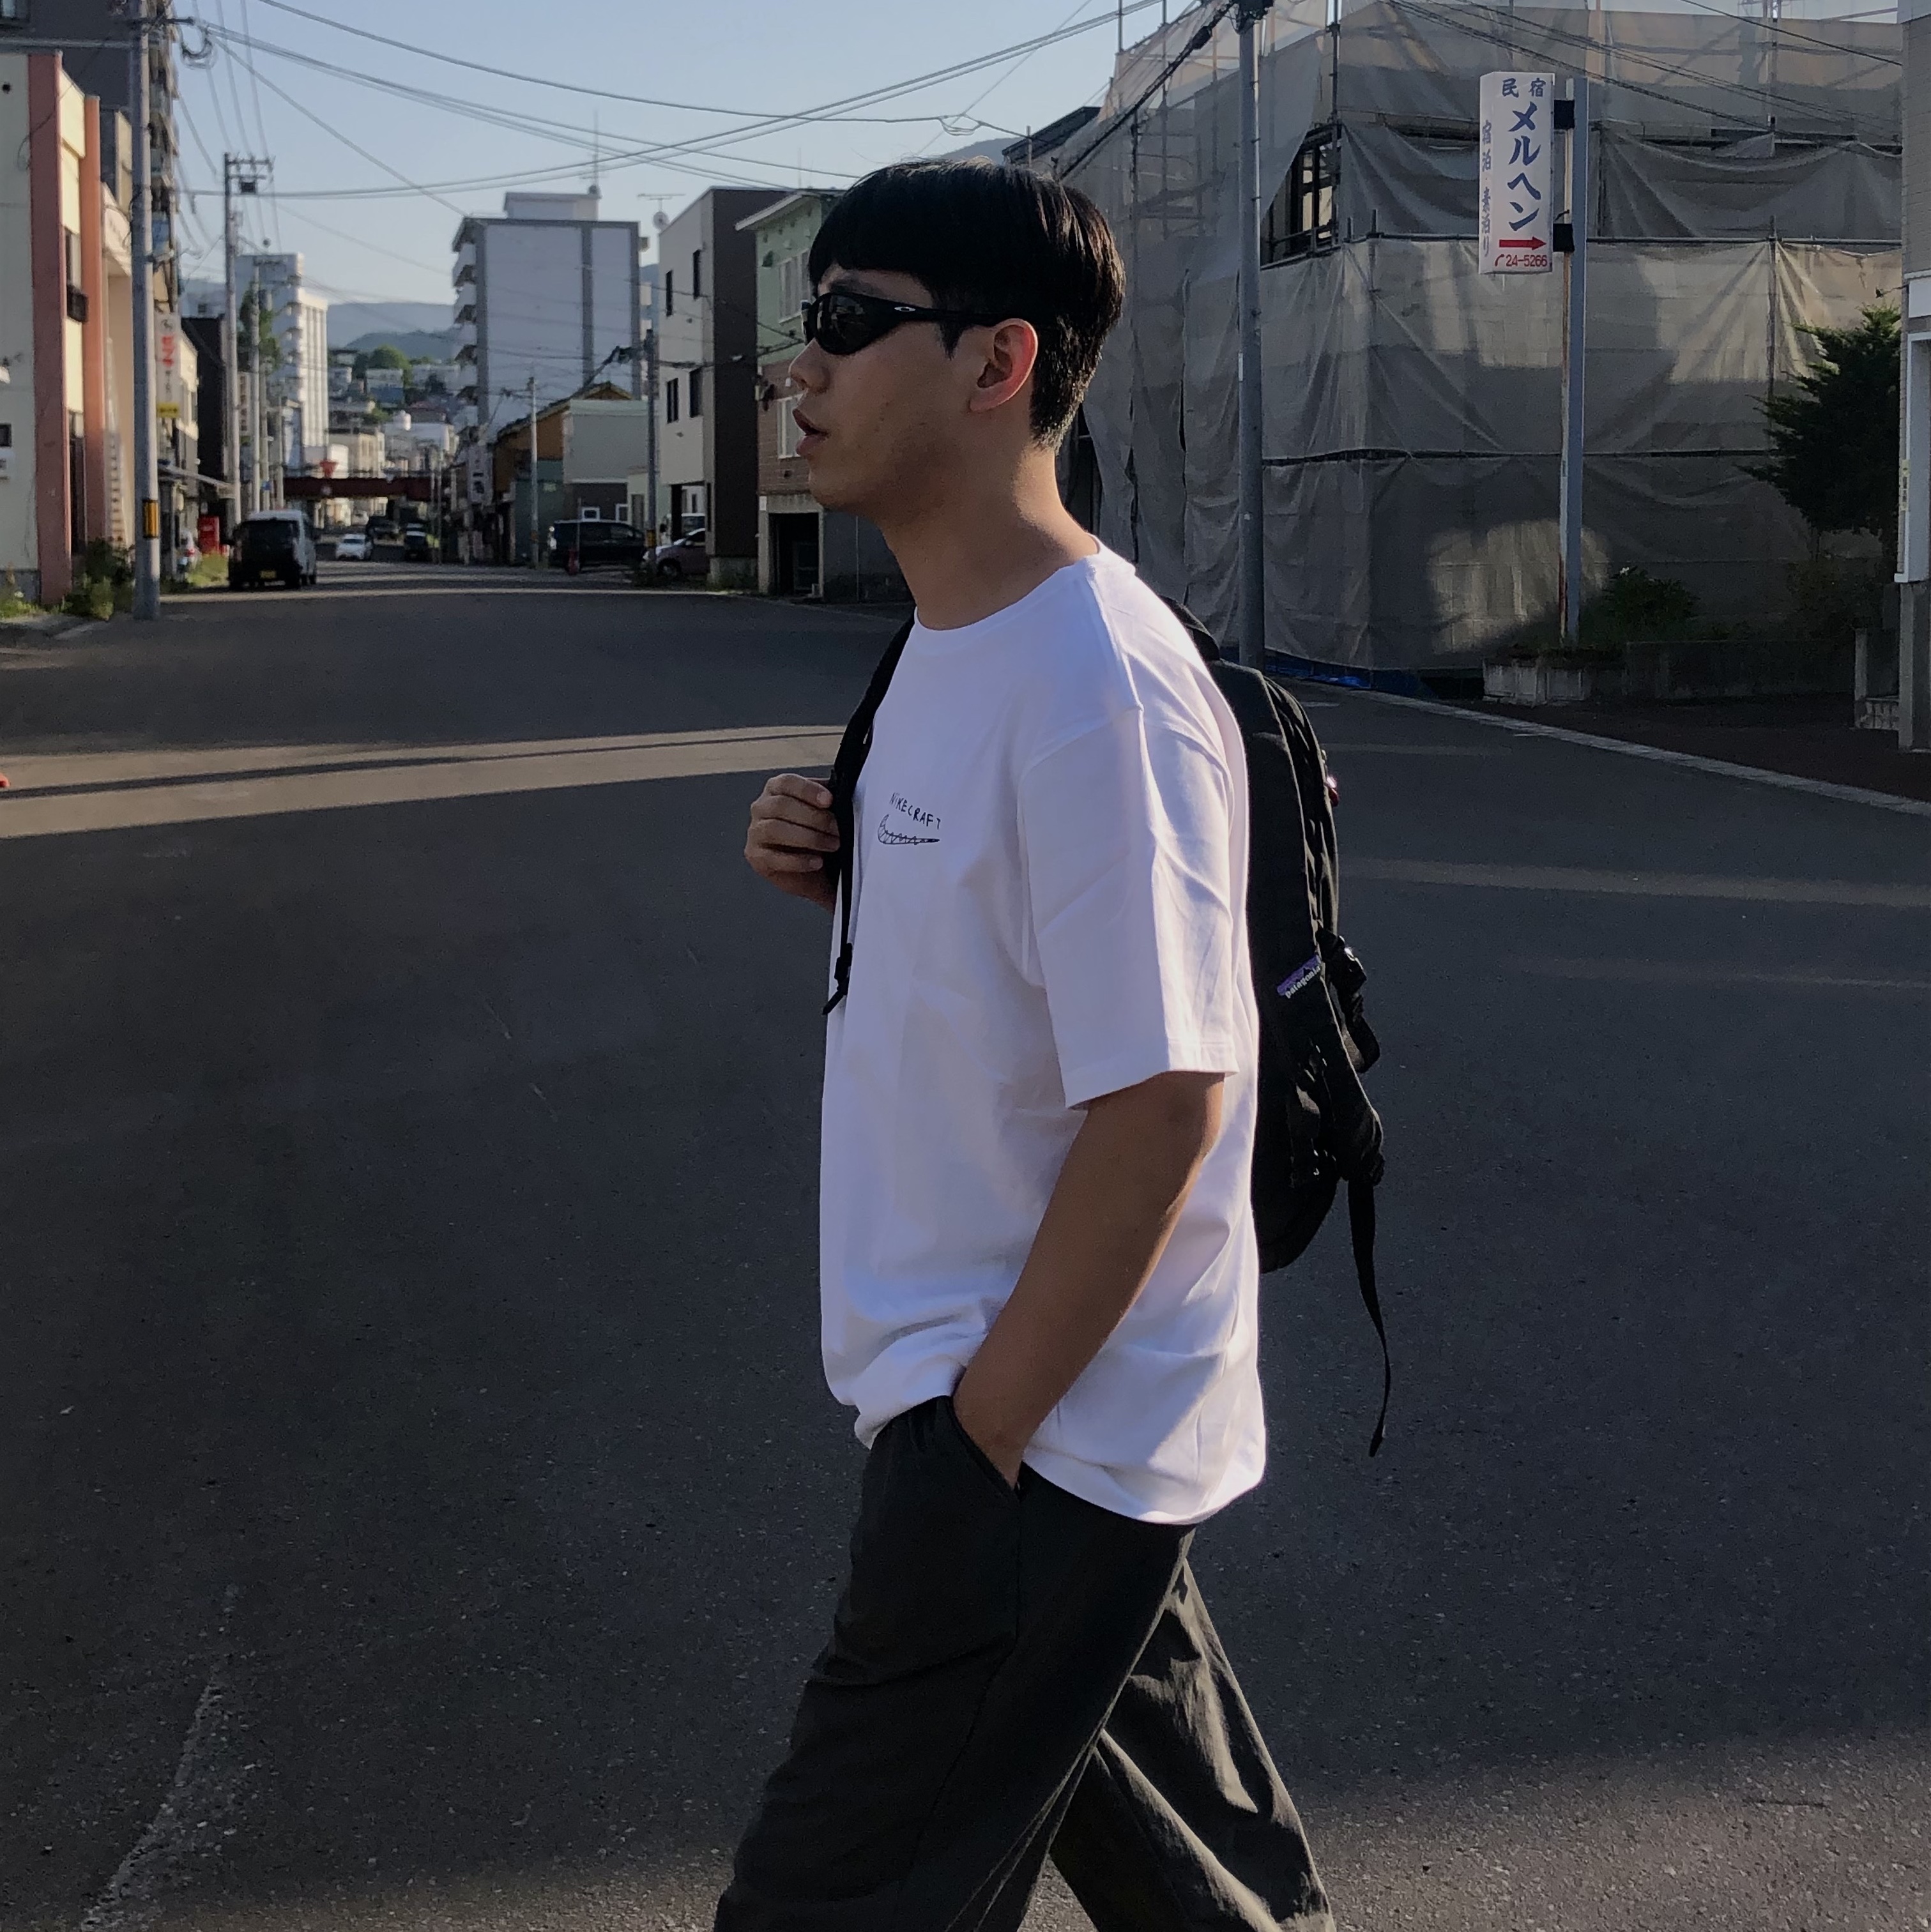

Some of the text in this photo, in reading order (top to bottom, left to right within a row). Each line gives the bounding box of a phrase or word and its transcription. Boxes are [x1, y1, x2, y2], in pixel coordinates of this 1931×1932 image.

[1502, 78, 1546, 97] 民宿
[1507, 101, 1541, 231] メルヘン
[1506, 254, 1548, 267] 24-5266
[890, 792, 941, 830] NIKECRAFT
[1285, 965, 1321, 999] patagonia
